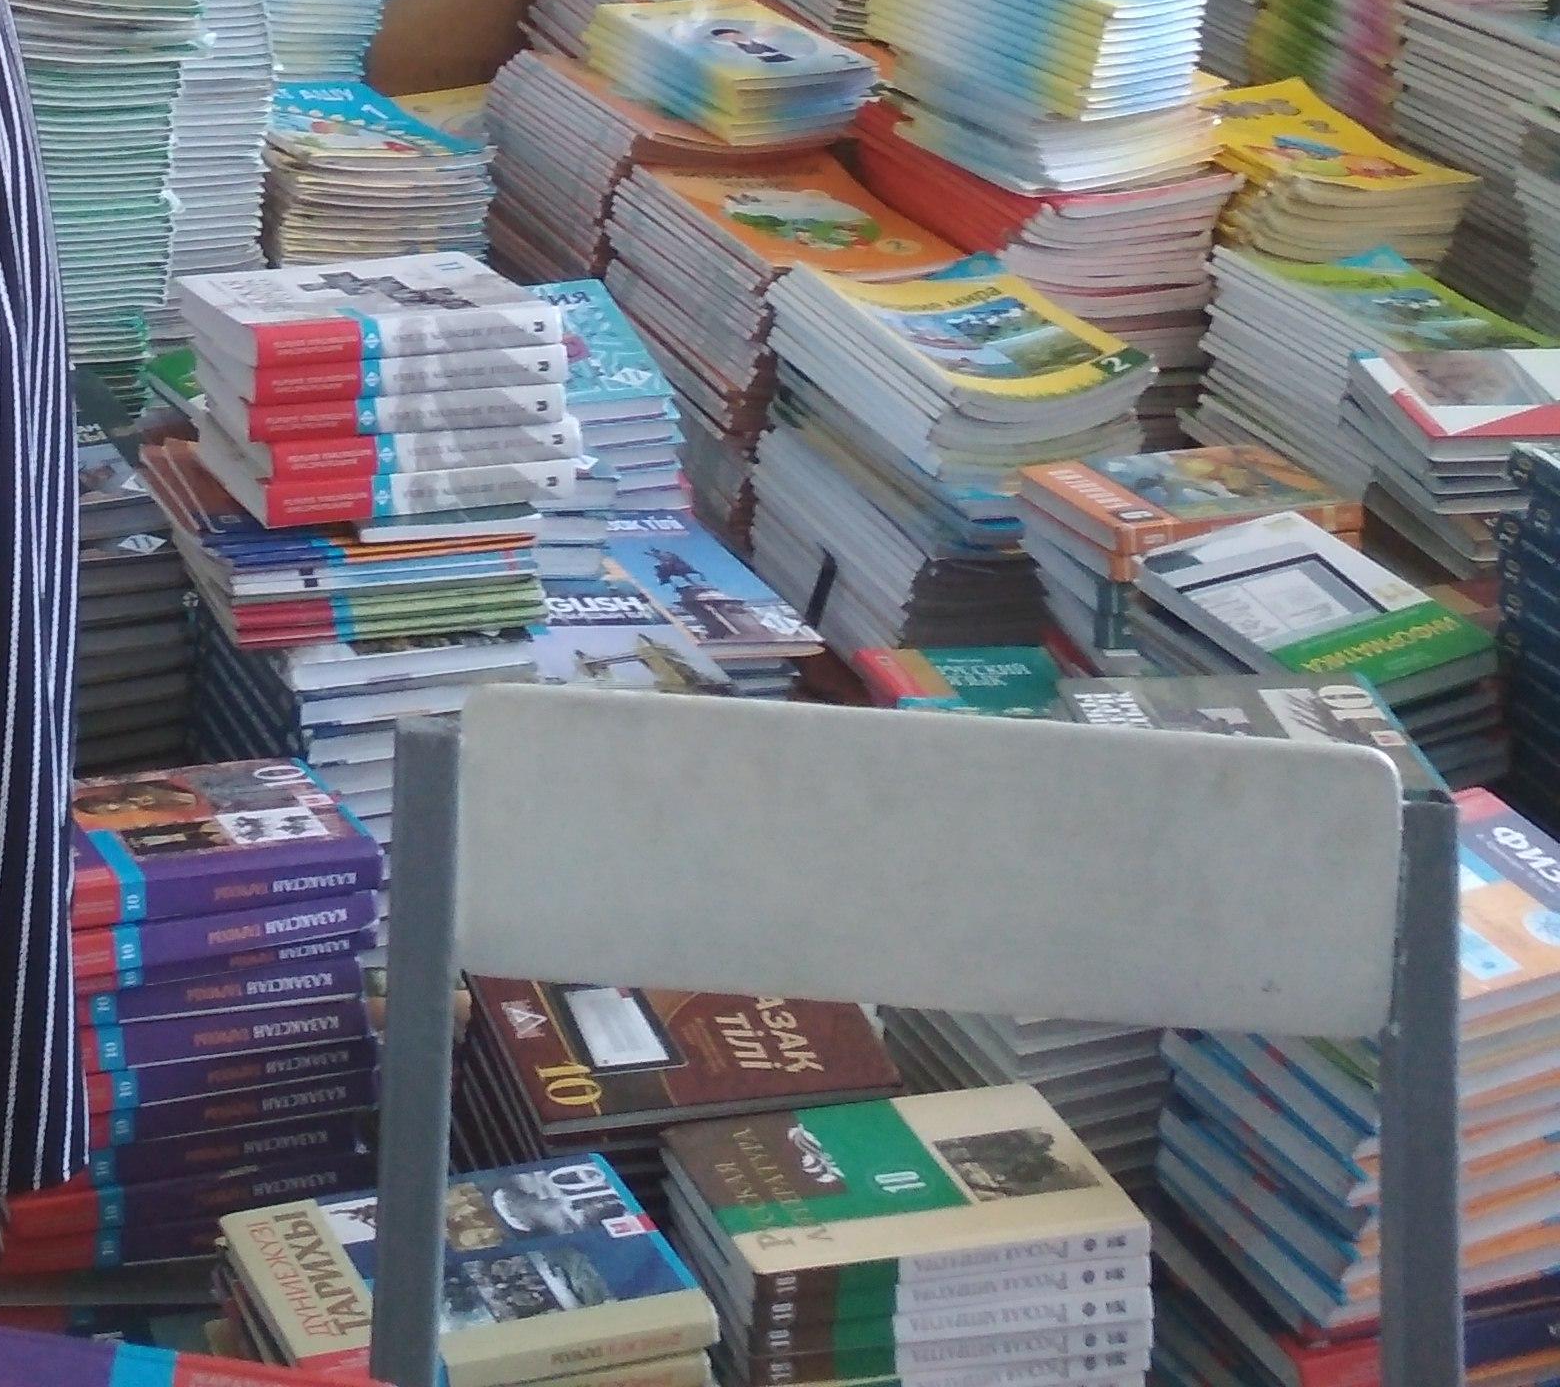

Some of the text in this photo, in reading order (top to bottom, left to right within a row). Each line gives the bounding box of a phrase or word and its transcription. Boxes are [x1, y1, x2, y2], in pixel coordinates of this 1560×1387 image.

[544, 595, 646, 614] GLISH
[126, 894, 140, 910] 10
[122, 944, 134, 959] 10
[96, 997, 110, 1011] 10
[104, 1043, 118, 1058] 10
[119, 1081, 132, 1096] 10
[535, 1060, 602, 1105] 10
[874, 1172, 928, 1195] 10
[273, 1211, 370, 1331] ТАРИХЫ
